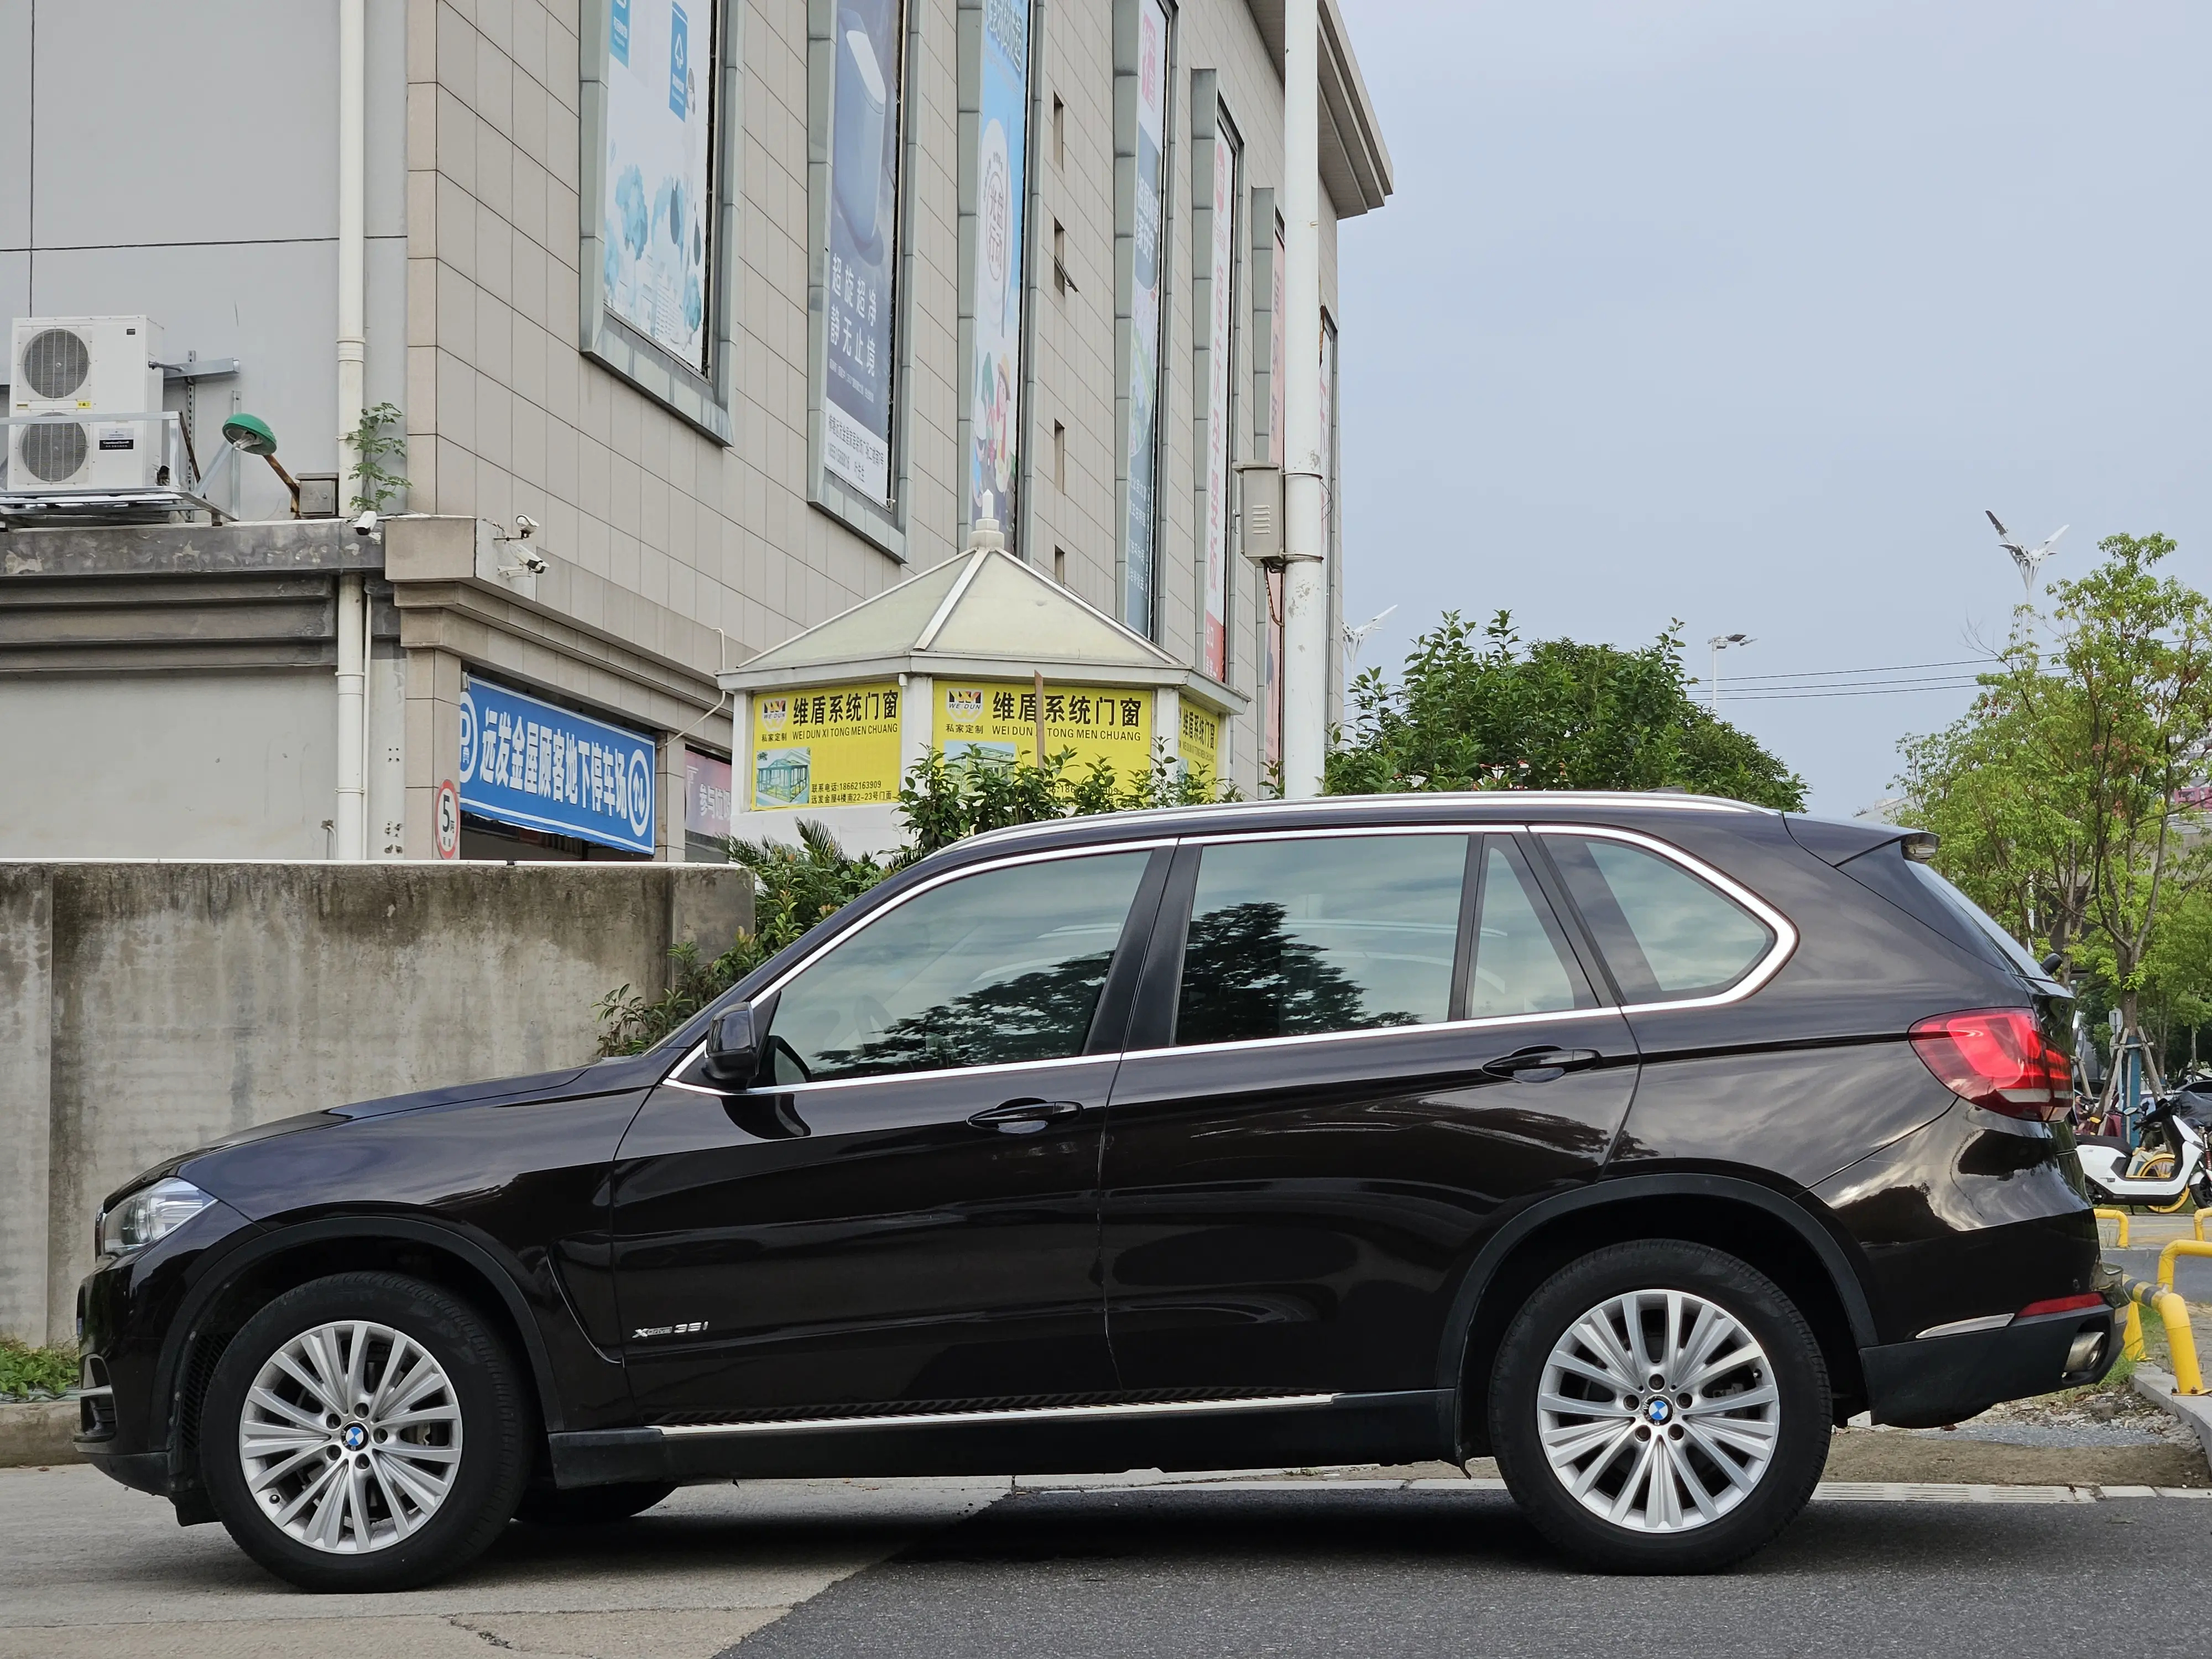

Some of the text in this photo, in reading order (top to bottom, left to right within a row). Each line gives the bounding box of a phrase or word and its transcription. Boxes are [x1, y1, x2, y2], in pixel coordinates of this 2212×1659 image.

[1136, 211, 1155, 264] 家安宁
[831, 252, 877, 327] 超旋超净
[830, 302, 876, 378] 静无止境
[792, 690, 899, 727] 维盾系统门窗
[992, 691, 1142, 728] 维盾系统门窗
[761, 732, 787, 743] 私家定制
[792, 723, 898, 740] WEI DUN XI TONG MEN CHUANG
[946, 723, 984, 734] 私家定制
[992, 725, 1033, 736] WEI DUN
[1047, 727, 1141, 742] TONG MEN CHUANG
[1182, 707, 1215, 750] 维盾系统门窗
[481, 706, 627, 820] 远发金屋顾客地下停车场
[442, 794, 450, 833] 5
